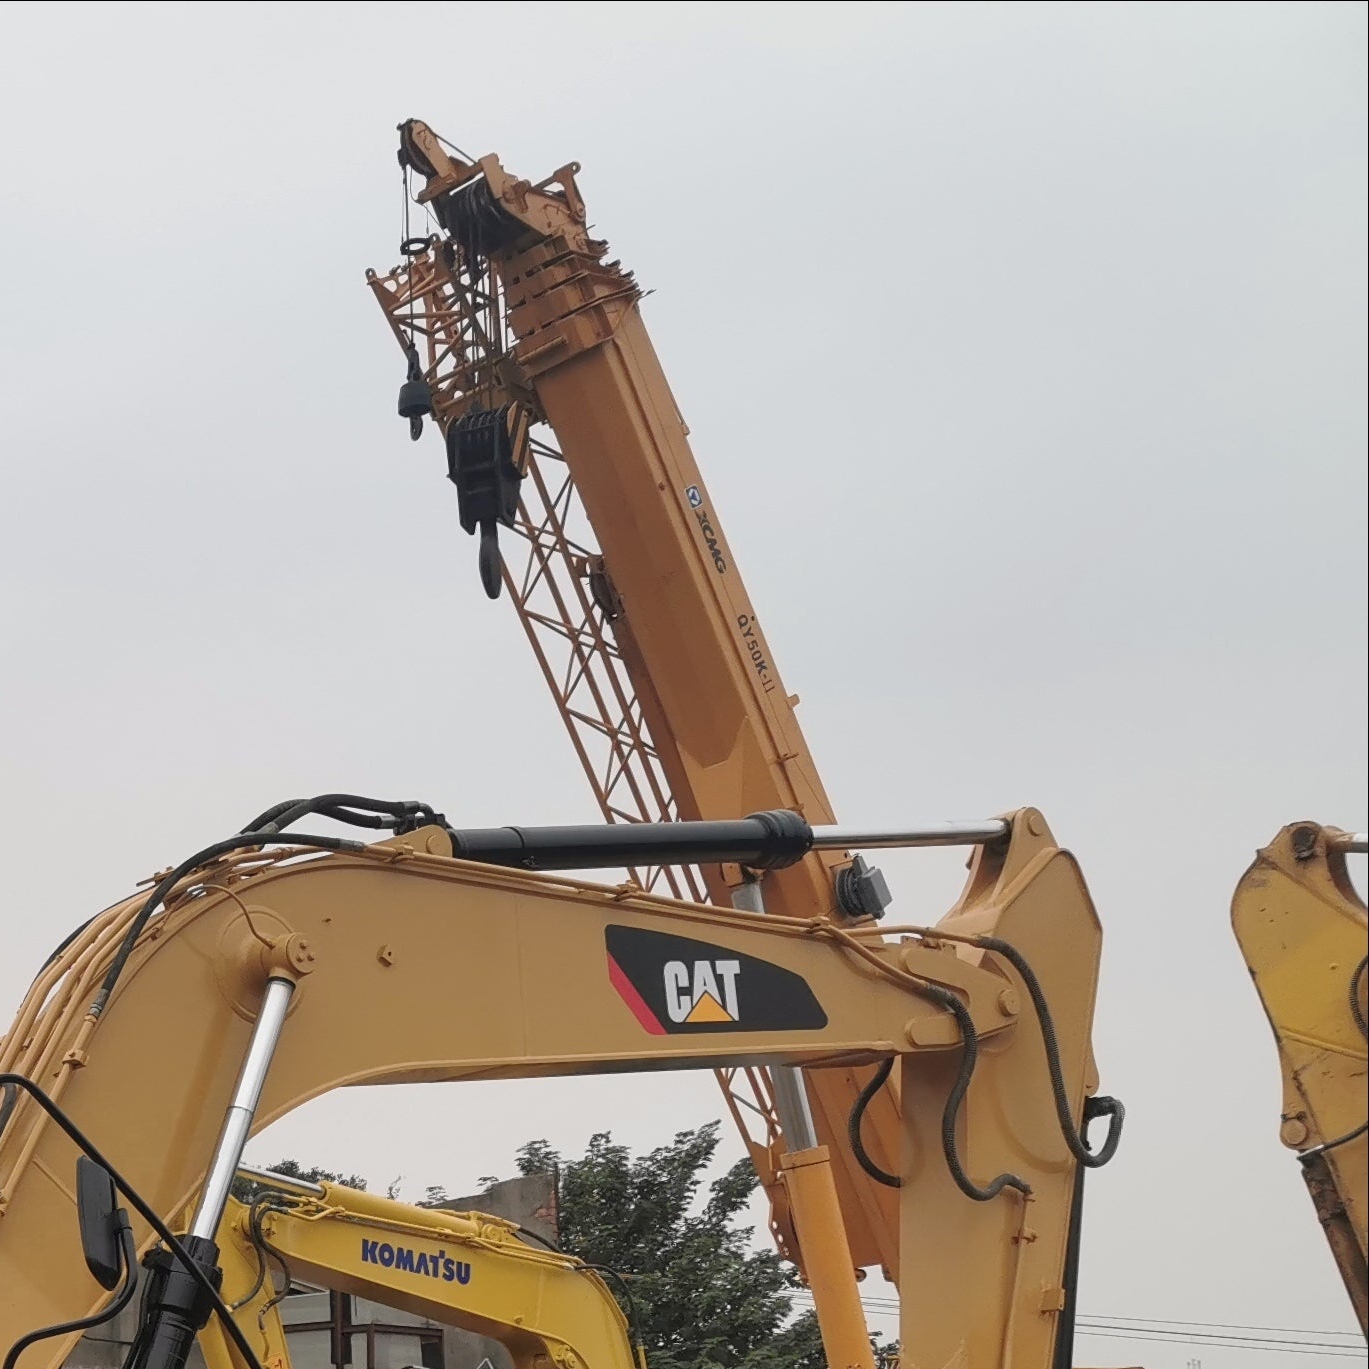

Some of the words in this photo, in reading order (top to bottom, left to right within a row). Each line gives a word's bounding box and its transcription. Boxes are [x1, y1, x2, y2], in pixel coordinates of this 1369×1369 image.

[695, 510, 727, 574] XCMG
[663, 960, 741, 1023] CAT
[361, 1238, 471, 1286] KOMATSU
